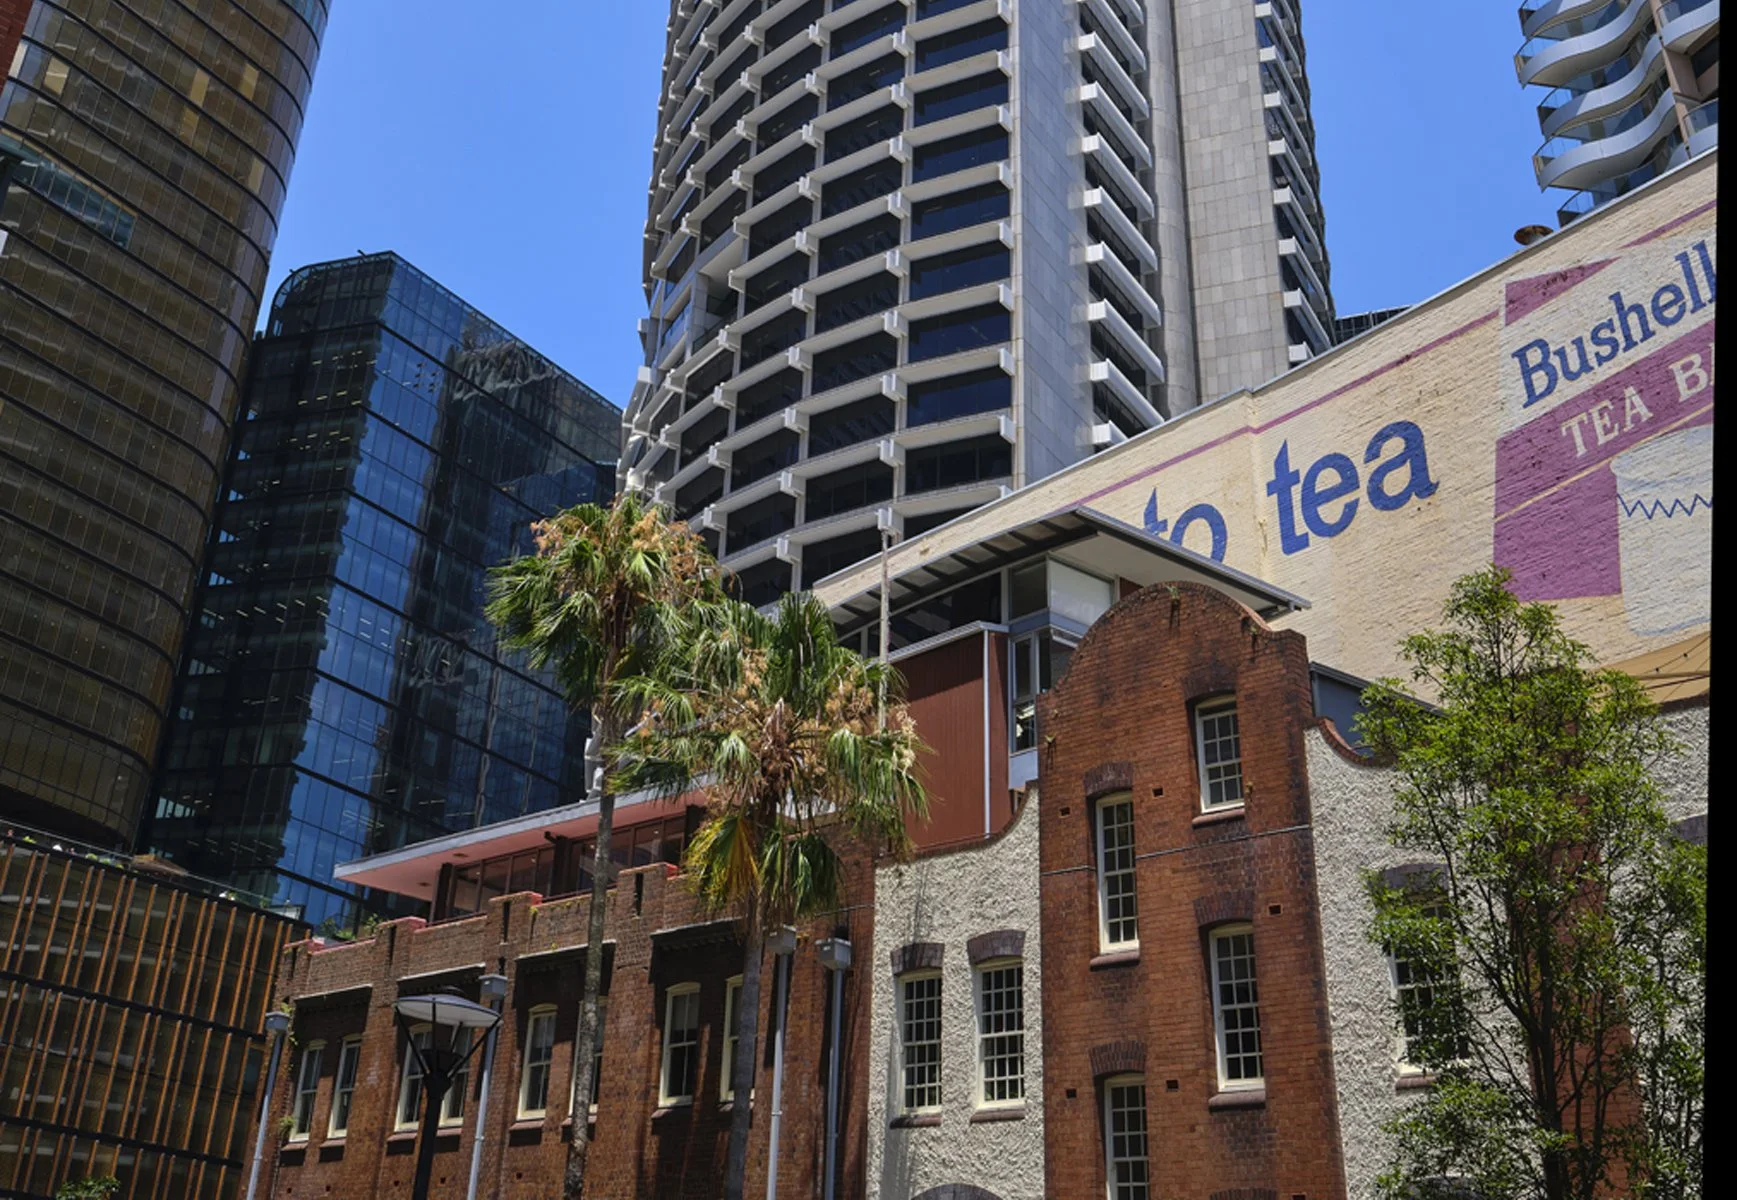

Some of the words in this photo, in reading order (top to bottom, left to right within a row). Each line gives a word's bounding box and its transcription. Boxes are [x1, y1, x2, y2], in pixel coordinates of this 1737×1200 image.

[1511, 239, 1716, 409] Bushell
[1266, 420, 1440, 556] tea
[1561, 385, 1653, 458] TEA
